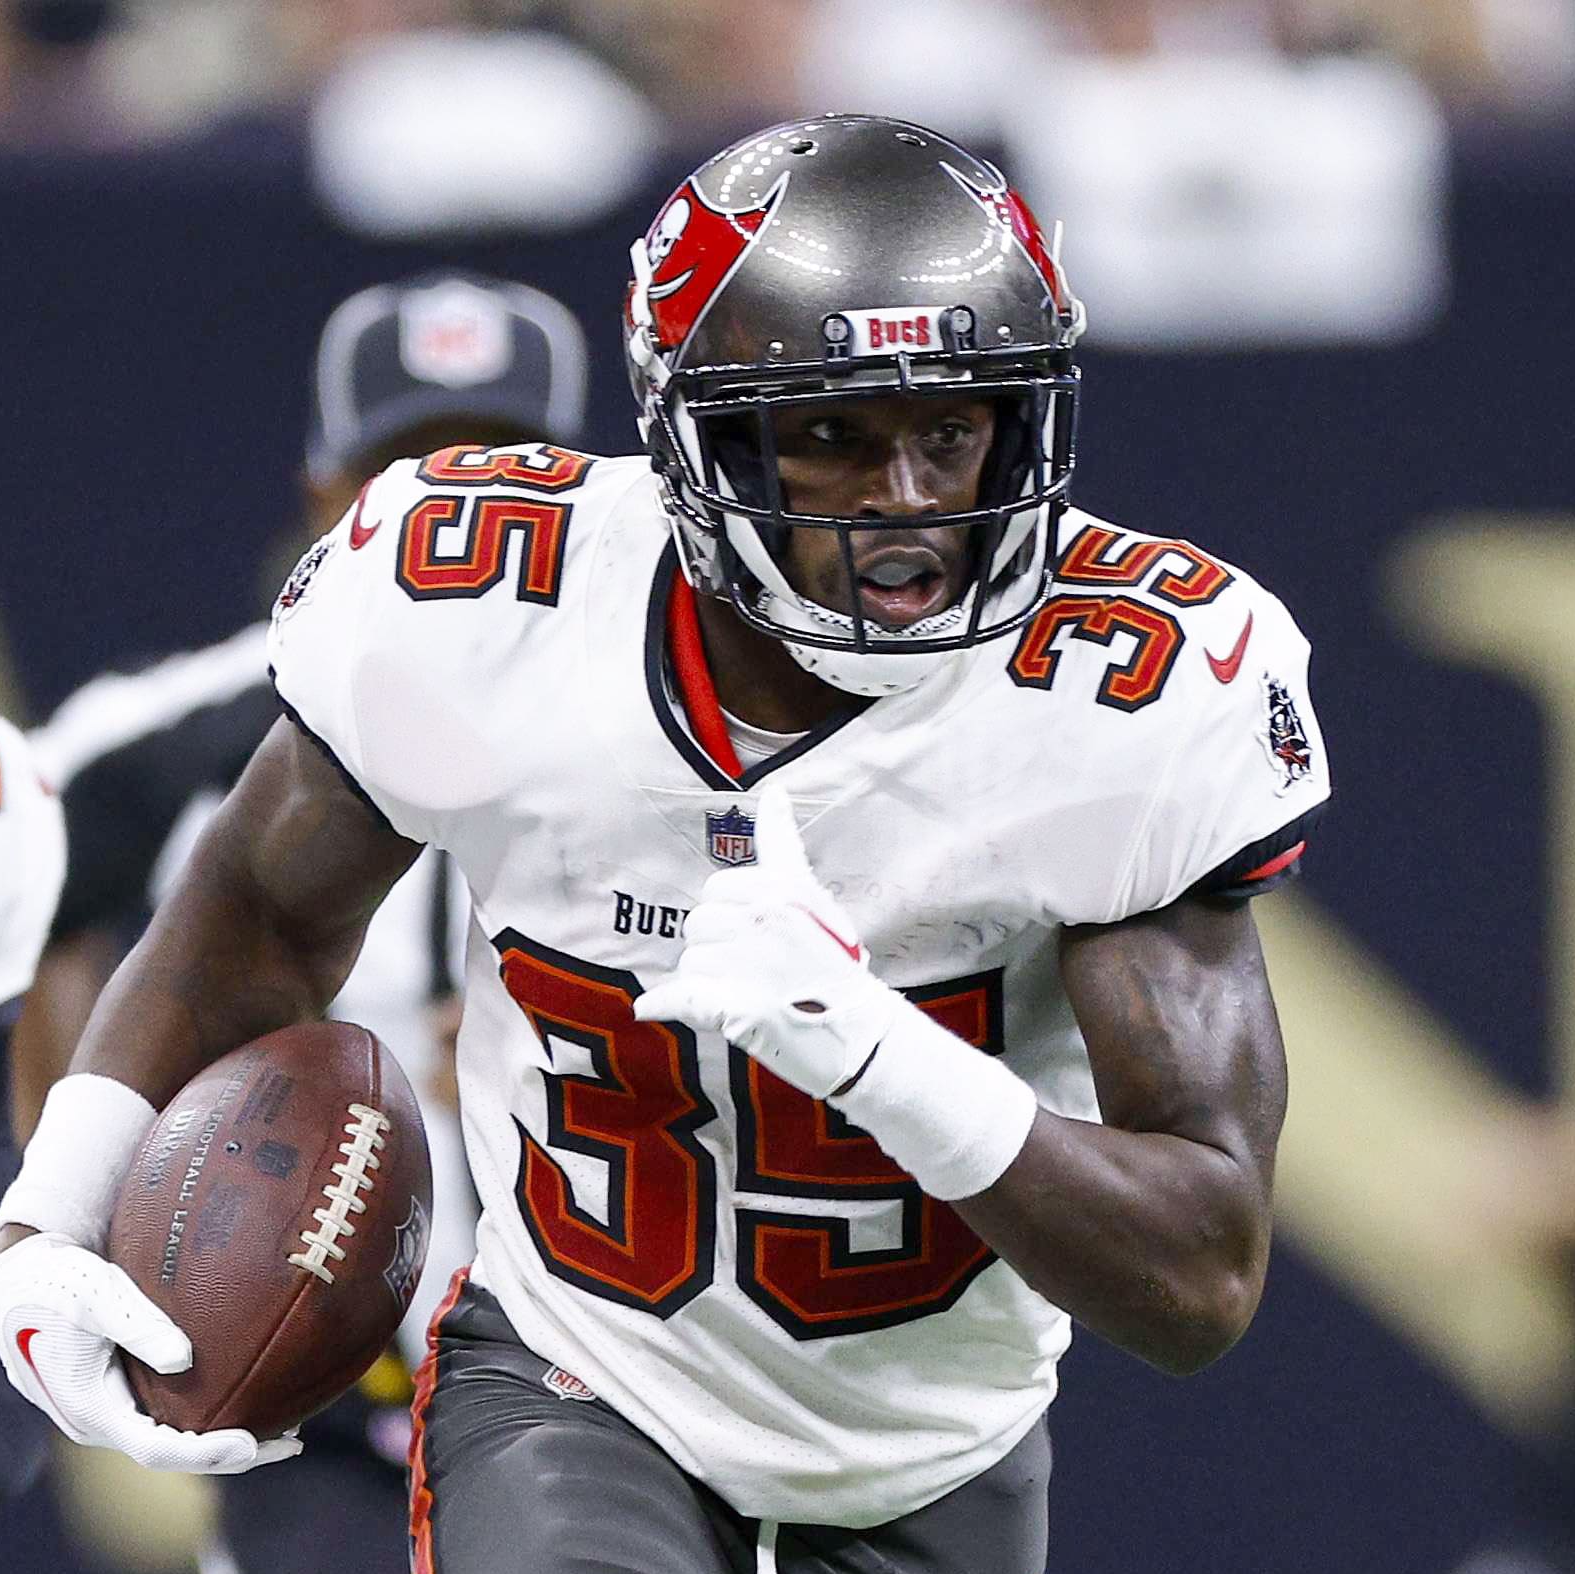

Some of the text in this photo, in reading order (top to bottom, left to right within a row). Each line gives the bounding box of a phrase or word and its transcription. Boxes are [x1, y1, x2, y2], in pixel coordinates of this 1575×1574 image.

[867, 316, 930, 348] BUCS
[395, 444, 597, 607] 35
[1006, 524, 1237, 714] 35
[715, 835, 754, 860] NFL
[178, 1109, 225, 1202] FOOTBALL
[490, 925, 1006, 1341] 35
[161, 1206, 190, 1287] LEAGUE
